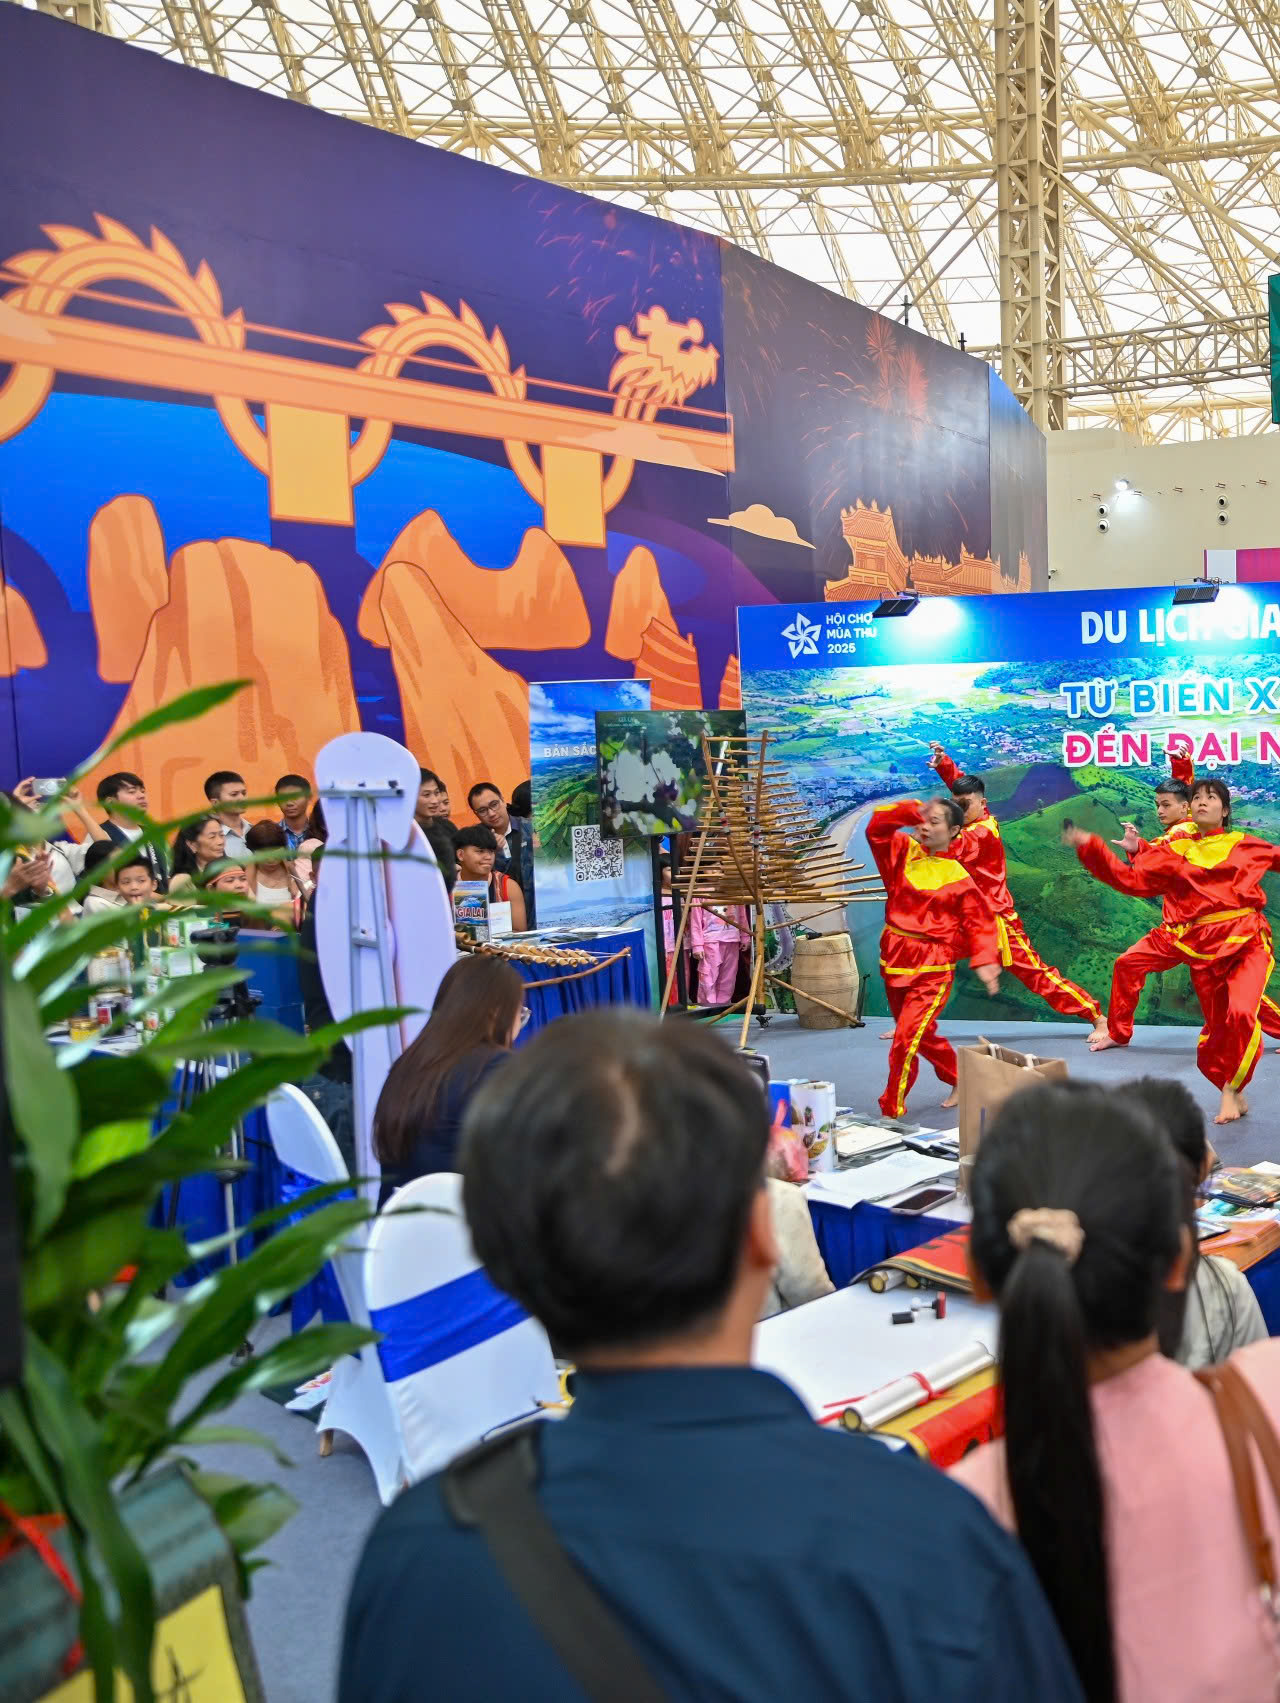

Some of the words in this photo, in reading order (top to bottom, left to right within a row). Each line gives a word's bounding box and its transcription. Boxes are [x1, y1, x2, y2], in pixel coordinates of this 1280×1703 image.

[826, 612, 846, 627] HỘI
[847, 611, 874, 626] CHỢ
[826, 626, 852, 639] MÙA
[853, 627, 878, 639] THU
[1081, 609, 1127, 645] DU
[827, 641, 857, 654] 2025
[1062, 677, 1116, 716] TỪ
[543, 743, 569, 758] BẢN
[1065, 726, 1149, 764] ĐẾN
[457, 907, 472, 918] GIA
[472, 906, 485, 919] LAI
